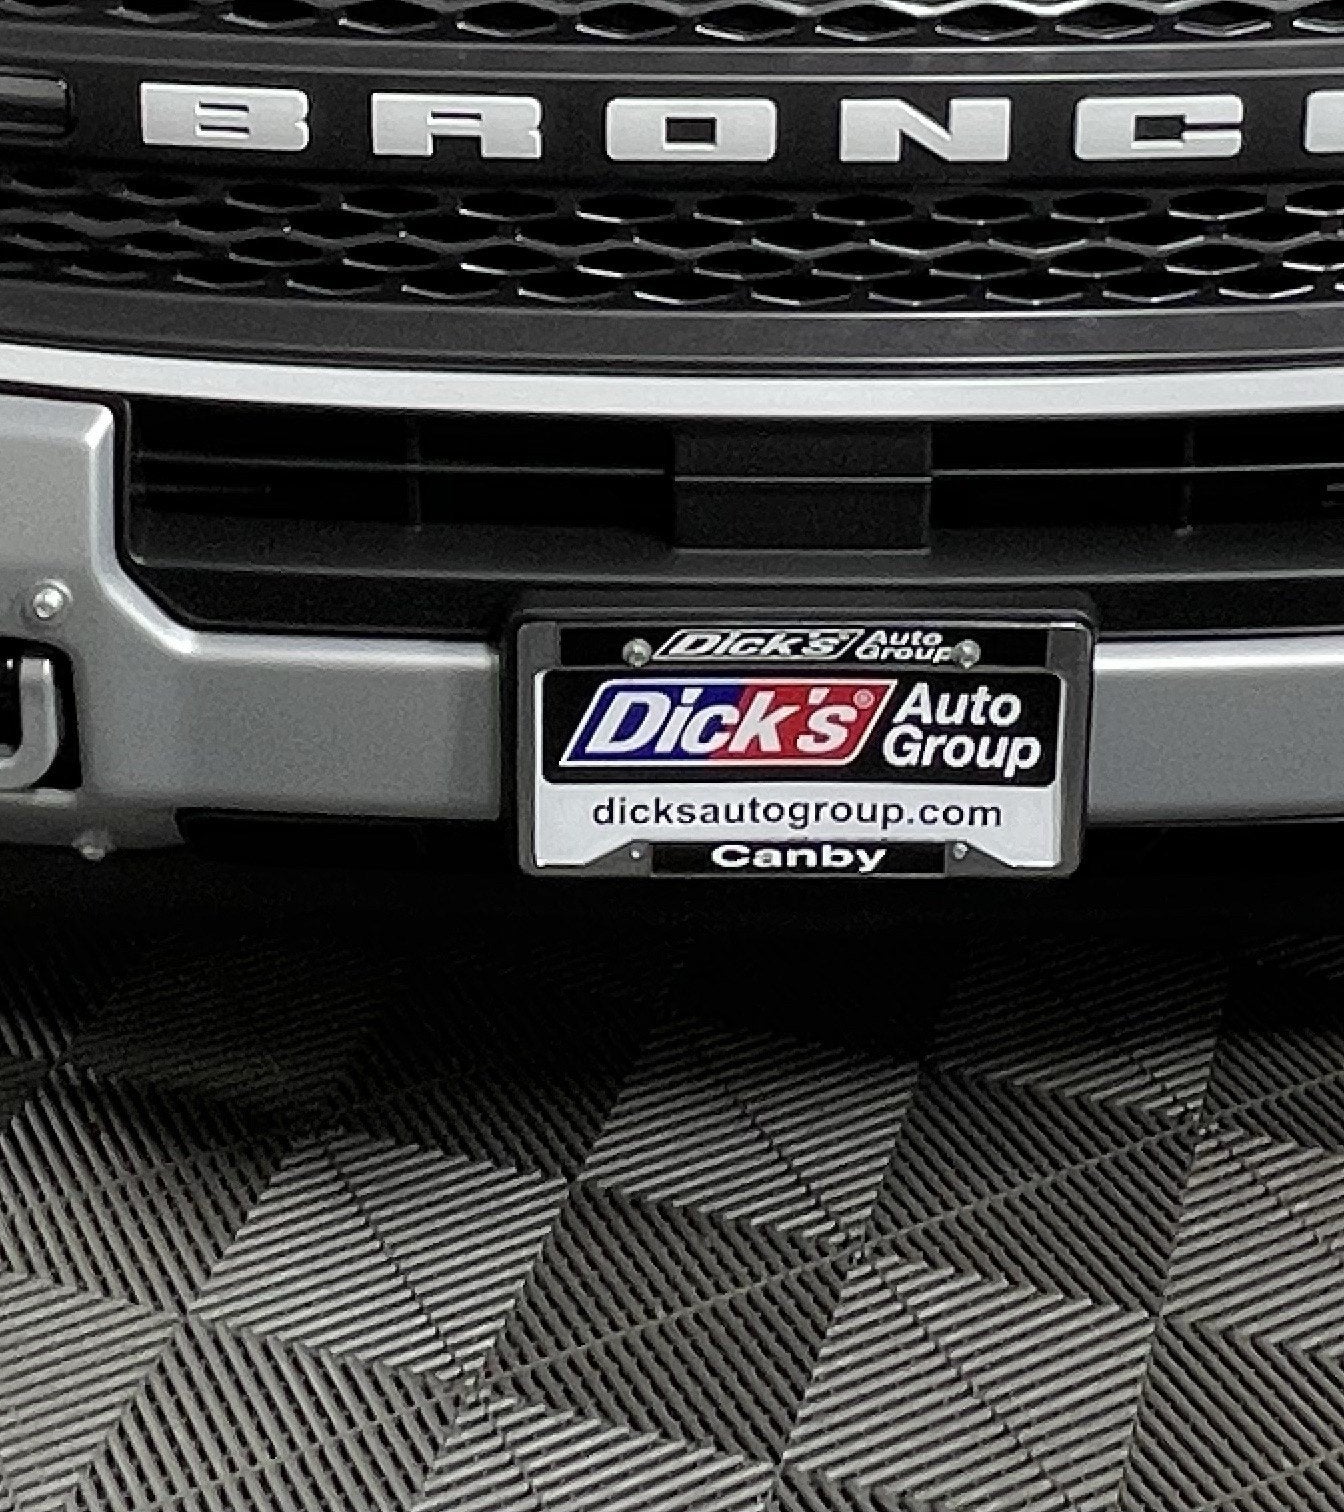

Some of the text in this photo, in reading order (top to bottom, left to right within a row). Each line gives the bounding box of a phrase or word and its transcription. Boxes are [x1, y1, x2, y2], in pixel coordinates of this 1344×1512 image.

[855, 645, 955, 663] Group
[863, 630, 944, 646] Auto
[892, 682, 1022, 726] Auto
[584, 687, 859, 756] Dick's
[882, 726, 1042, 778] Group
[592, 796, 1003, 830] dicksautogroup.com
[711, 843, 888, 874] Canby
